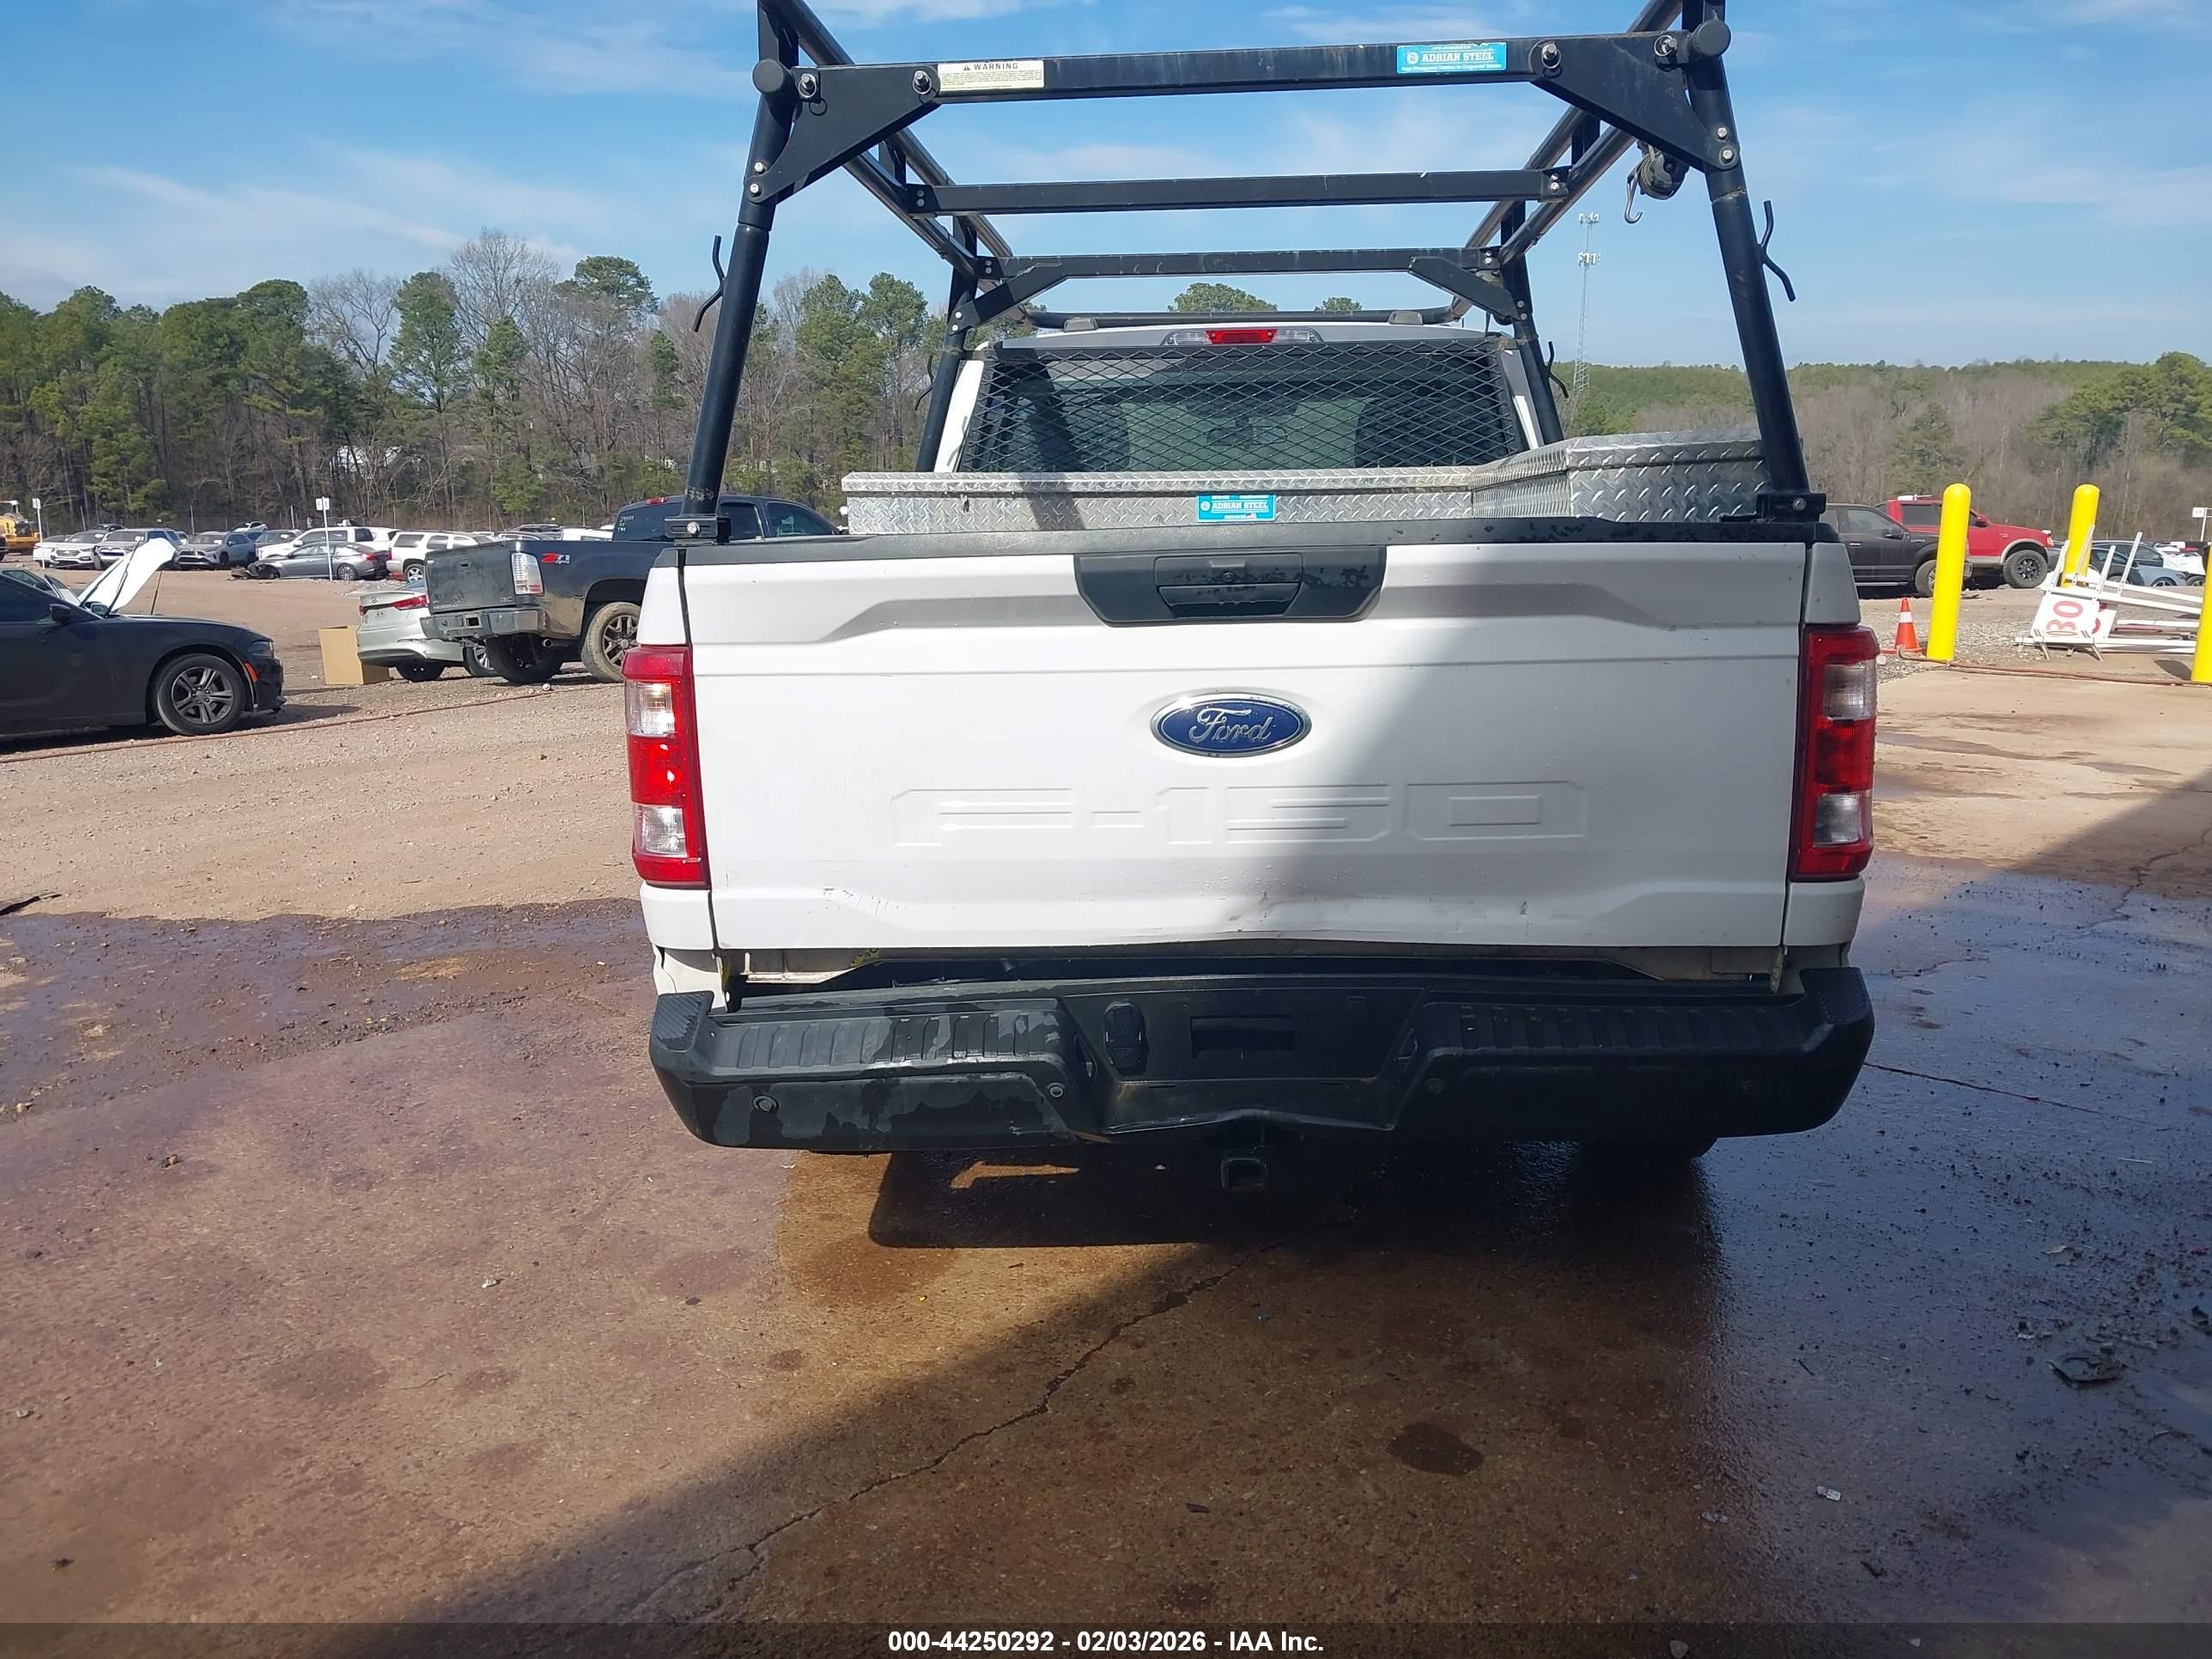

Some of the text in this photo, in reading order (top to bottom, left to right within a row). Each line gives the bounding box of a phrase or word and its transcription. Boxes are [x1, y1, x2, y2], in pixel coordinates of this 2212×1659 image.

[1421, 51, 1494, 62] ADRIAN STEEL
[974, 62, 1018, 70] WARNING
[1211, 501, 1242, 509] ADRIAN
[1188, 707, 1274, 744] Ford
[890, 781, 1588, 846] F-150
